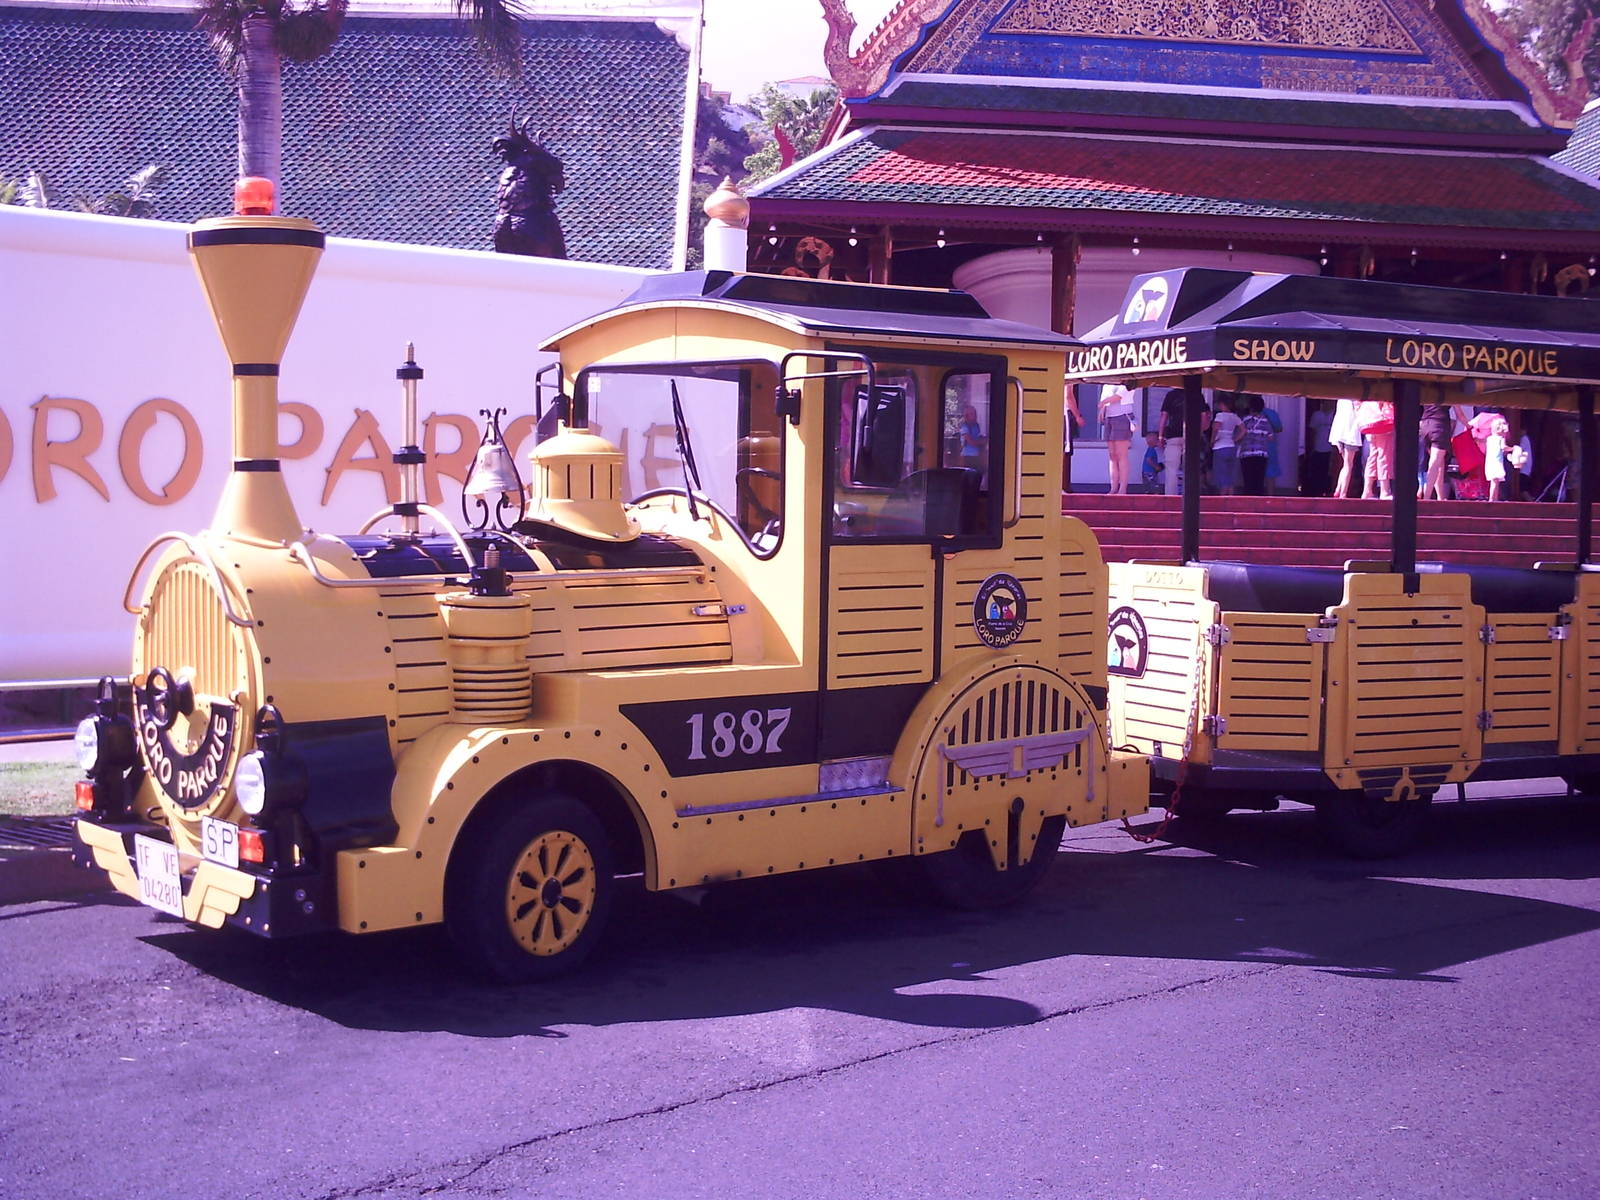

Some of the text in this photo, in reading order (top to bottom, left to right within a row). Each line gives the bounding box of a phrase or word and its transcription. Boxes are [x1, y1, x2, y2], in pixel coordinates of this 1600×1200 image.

[1068, 337, 1187, 373] LORO PARQUE
[1233, 339, 1315, 361] SHOW
[1385, 338, 1558, 375] LORO PARQUE
[0, 395, 203, 507] RO
[976, 618, 1024, 646] LORO PARQUE
[140, 703, 228, 798] LORO PARQUE
[685, 707, 791, 760] 1887
[138, 843, 177, 877] TF VE
[206, 823, 233, 861] SP
